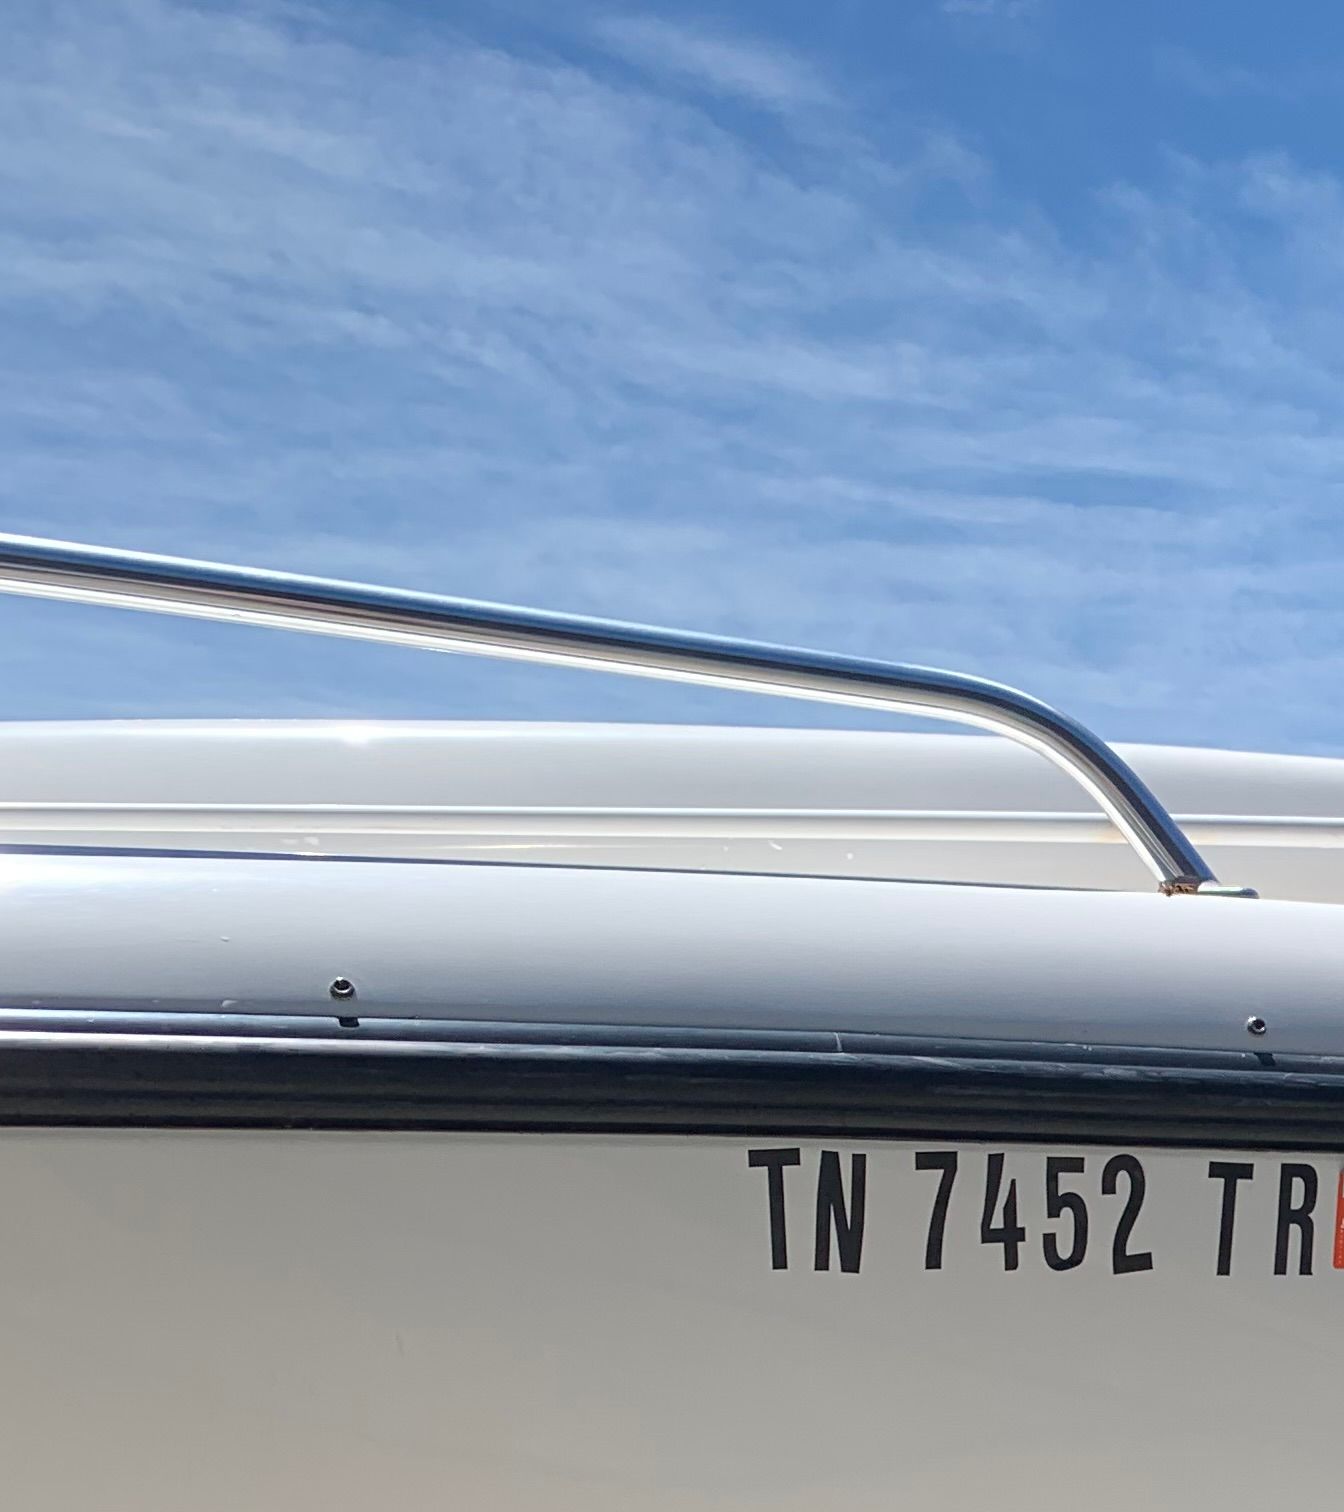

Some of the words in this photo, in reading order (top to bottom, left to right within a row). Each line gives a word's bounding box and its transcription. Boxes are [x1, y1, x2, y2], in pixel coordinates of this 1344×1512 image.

[748, 1148, 867, 1274] TN
[915, 1151, 1154, 1275] 7452
[1208, 1161, 1319, 1277] TR
